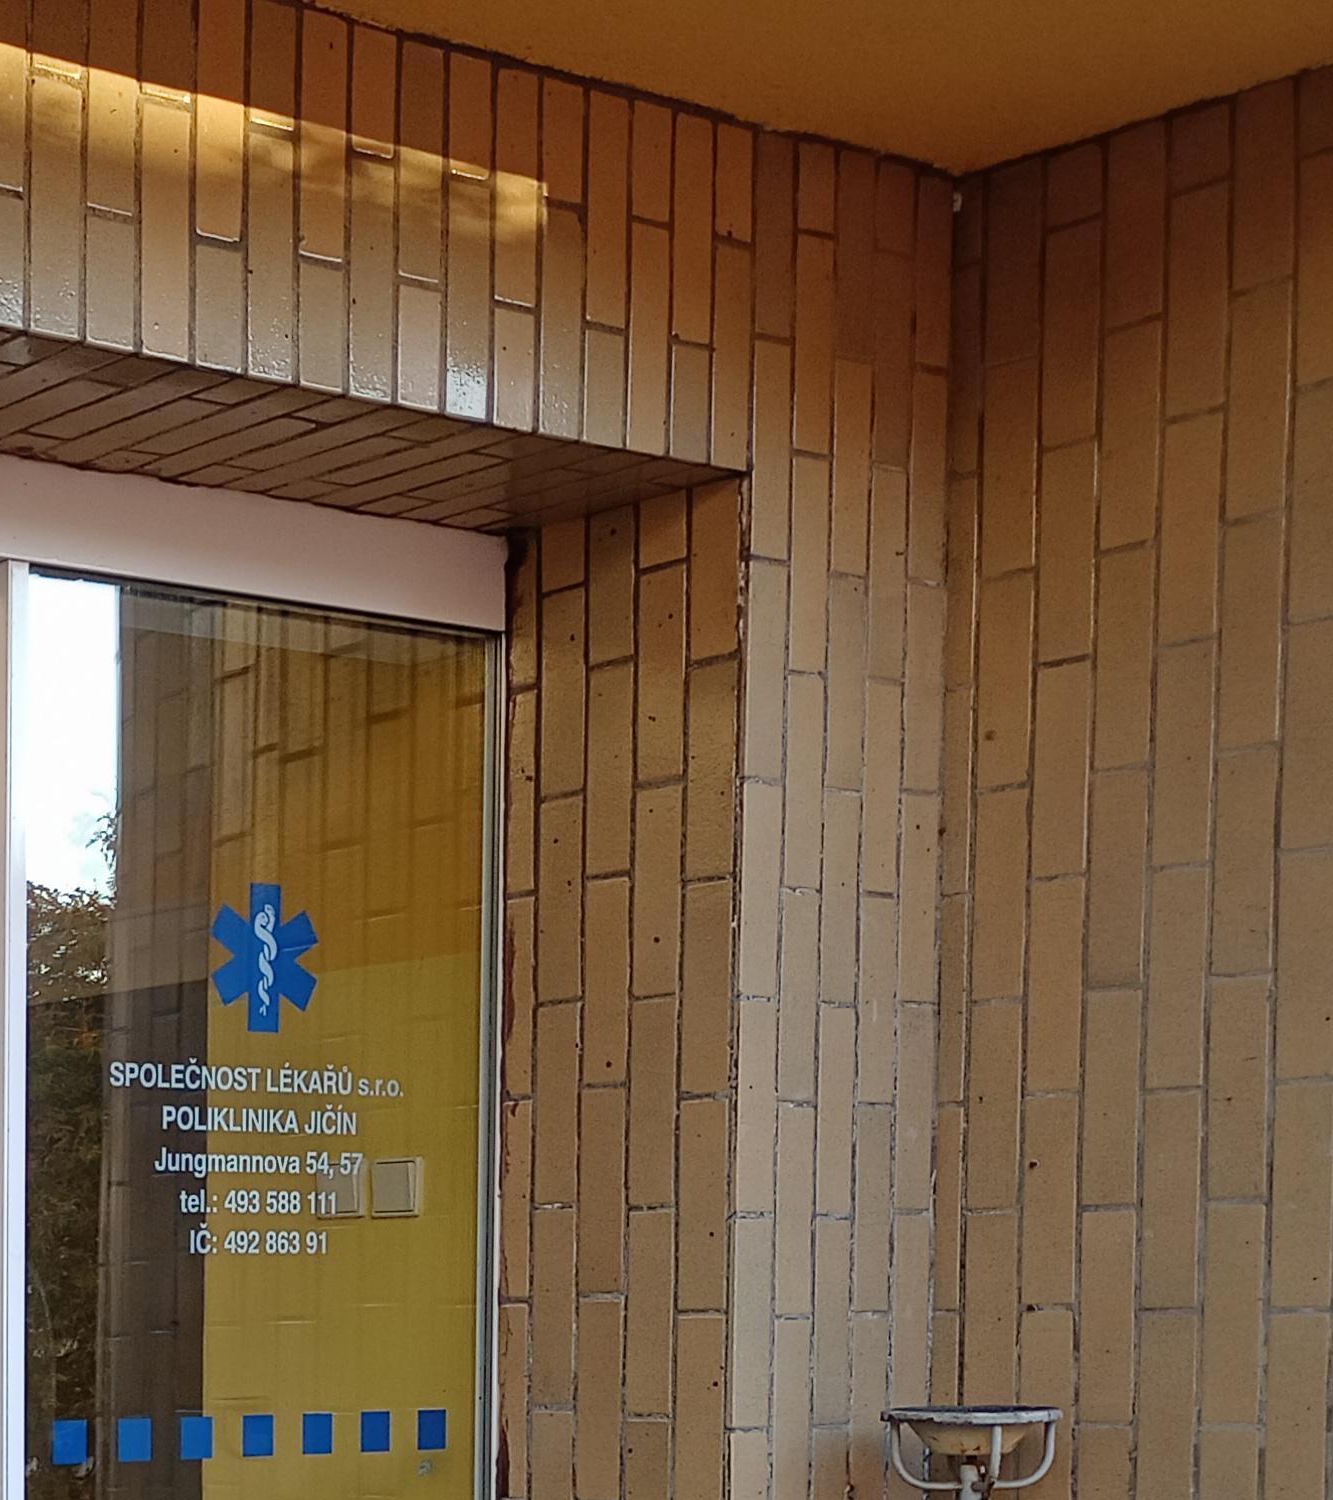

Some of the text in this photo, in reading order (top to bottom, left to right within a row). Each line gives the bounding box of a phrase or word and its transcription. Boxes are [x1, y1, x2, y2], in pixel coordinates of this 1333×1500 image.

[109, 1058, 404, 1097] SPOLEČNOST LÉKAŘŮ s.r.o.
[162, 1104, 357, 1135] POLIKLINIKA JIČÍN
[154, 1147, 364, 1179] Jungmannova 54, 57
[180, 1189, 337, 1215] tel.: 493 588 111
[190, 1223, 327, 1255] IČ: 492 863 91
